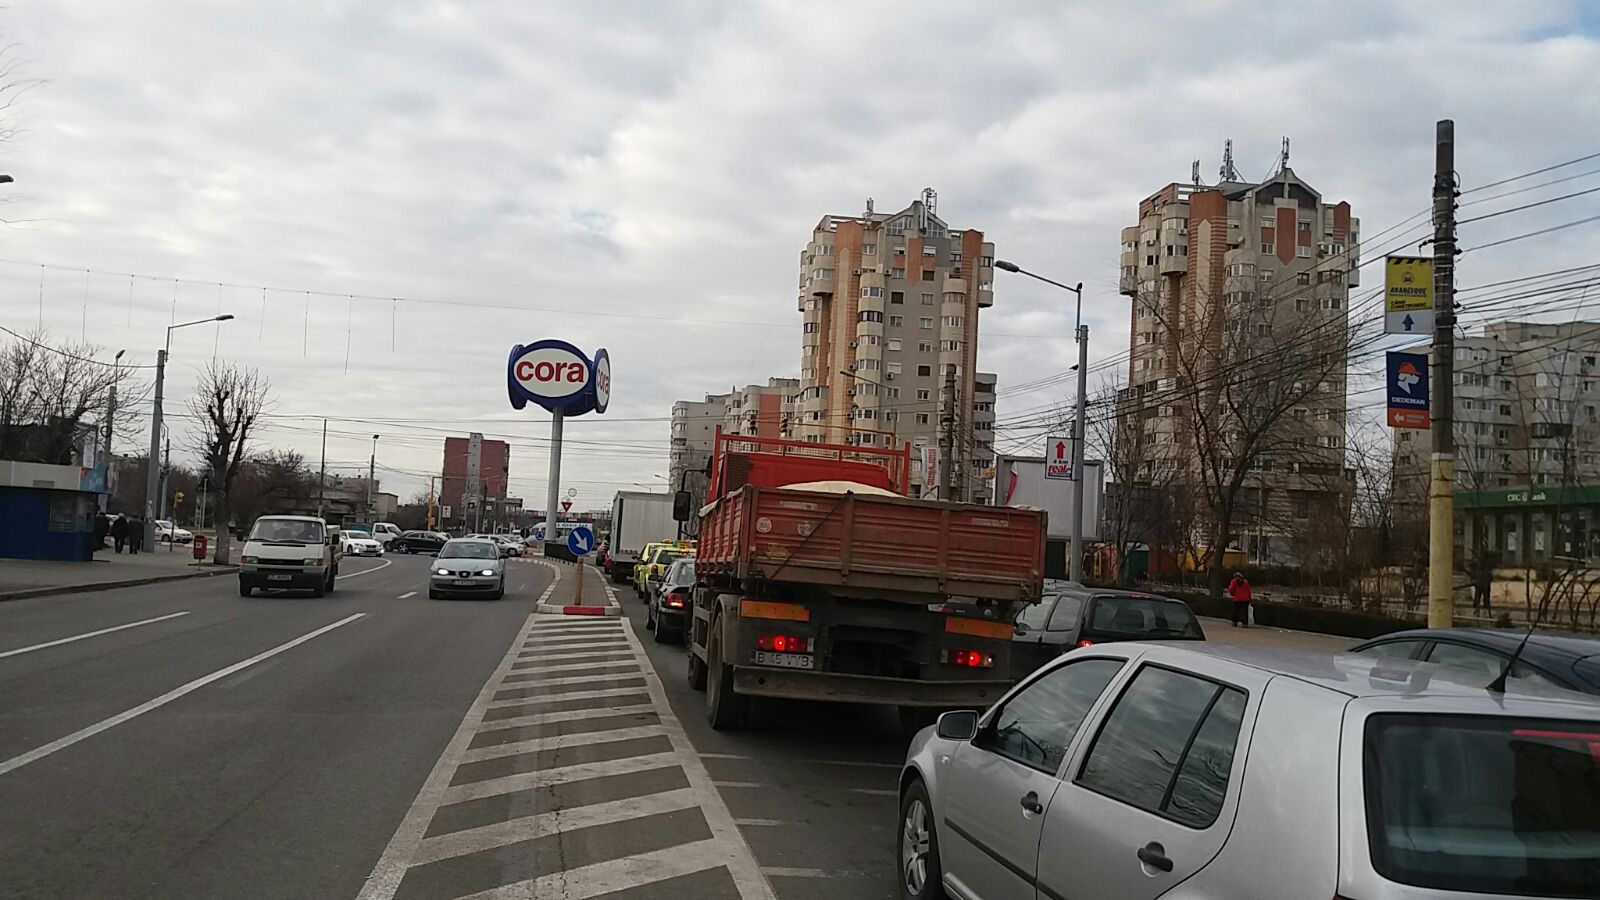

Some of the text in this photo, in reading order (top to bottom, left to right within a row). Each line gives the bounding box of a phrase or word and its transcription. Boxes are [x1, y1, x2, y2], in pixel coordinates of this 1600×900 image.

[516, 361, 585, 383] cora
[1391, 396, 1426, 405] DEDEMAN
[757, 652, 765, 663] B
